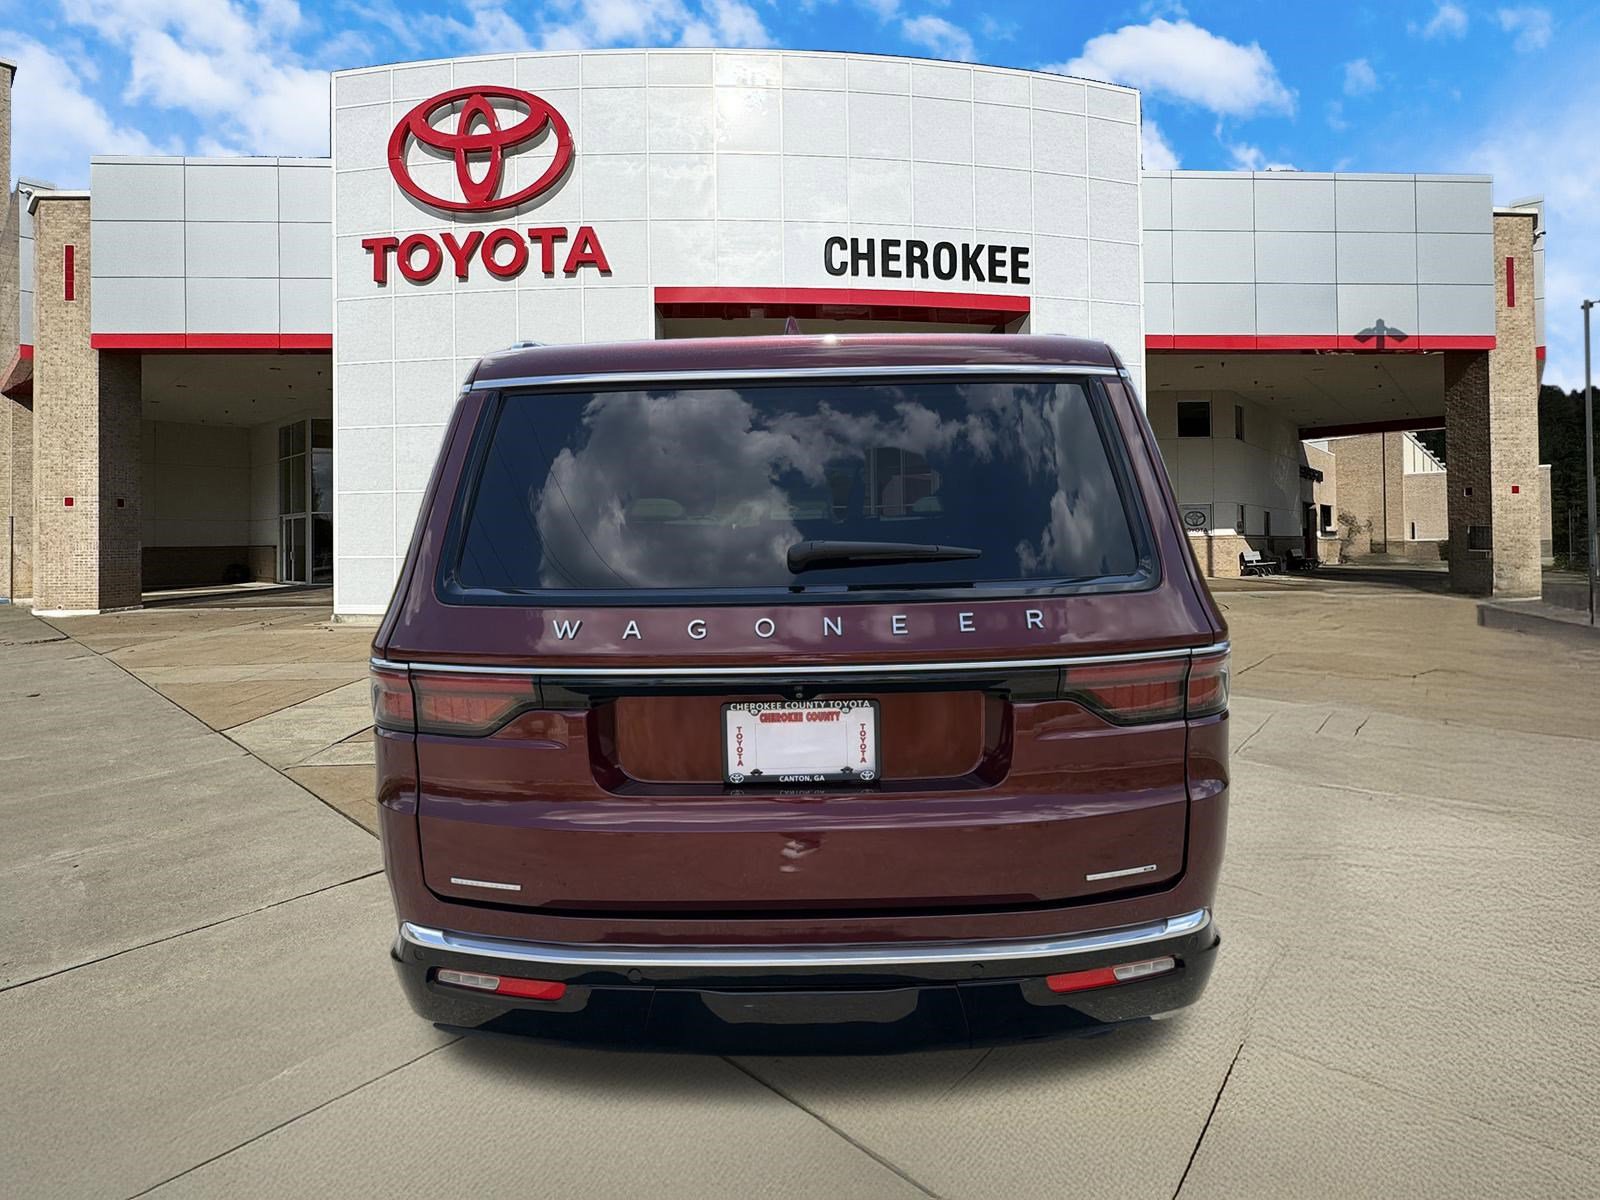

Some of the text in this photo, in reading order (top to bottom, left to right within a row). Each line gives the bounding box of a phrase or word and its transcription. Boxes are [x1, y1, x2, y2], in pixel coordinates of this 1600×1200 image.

[362, 226, 612, 286] TOYOTA
[824, 236, 1031, 285] CHEROKEE
[552, 609, 1045, 640] WAGONEER
[730, 700, 871, 711] CHEROKEE COUNTY TOYOTA
[760, 711, 840, 722] CHEROKEE COUNTY
[736, 726, 744, 767] TOYOTA
[859, 723, 867, 763] TOYOTA
